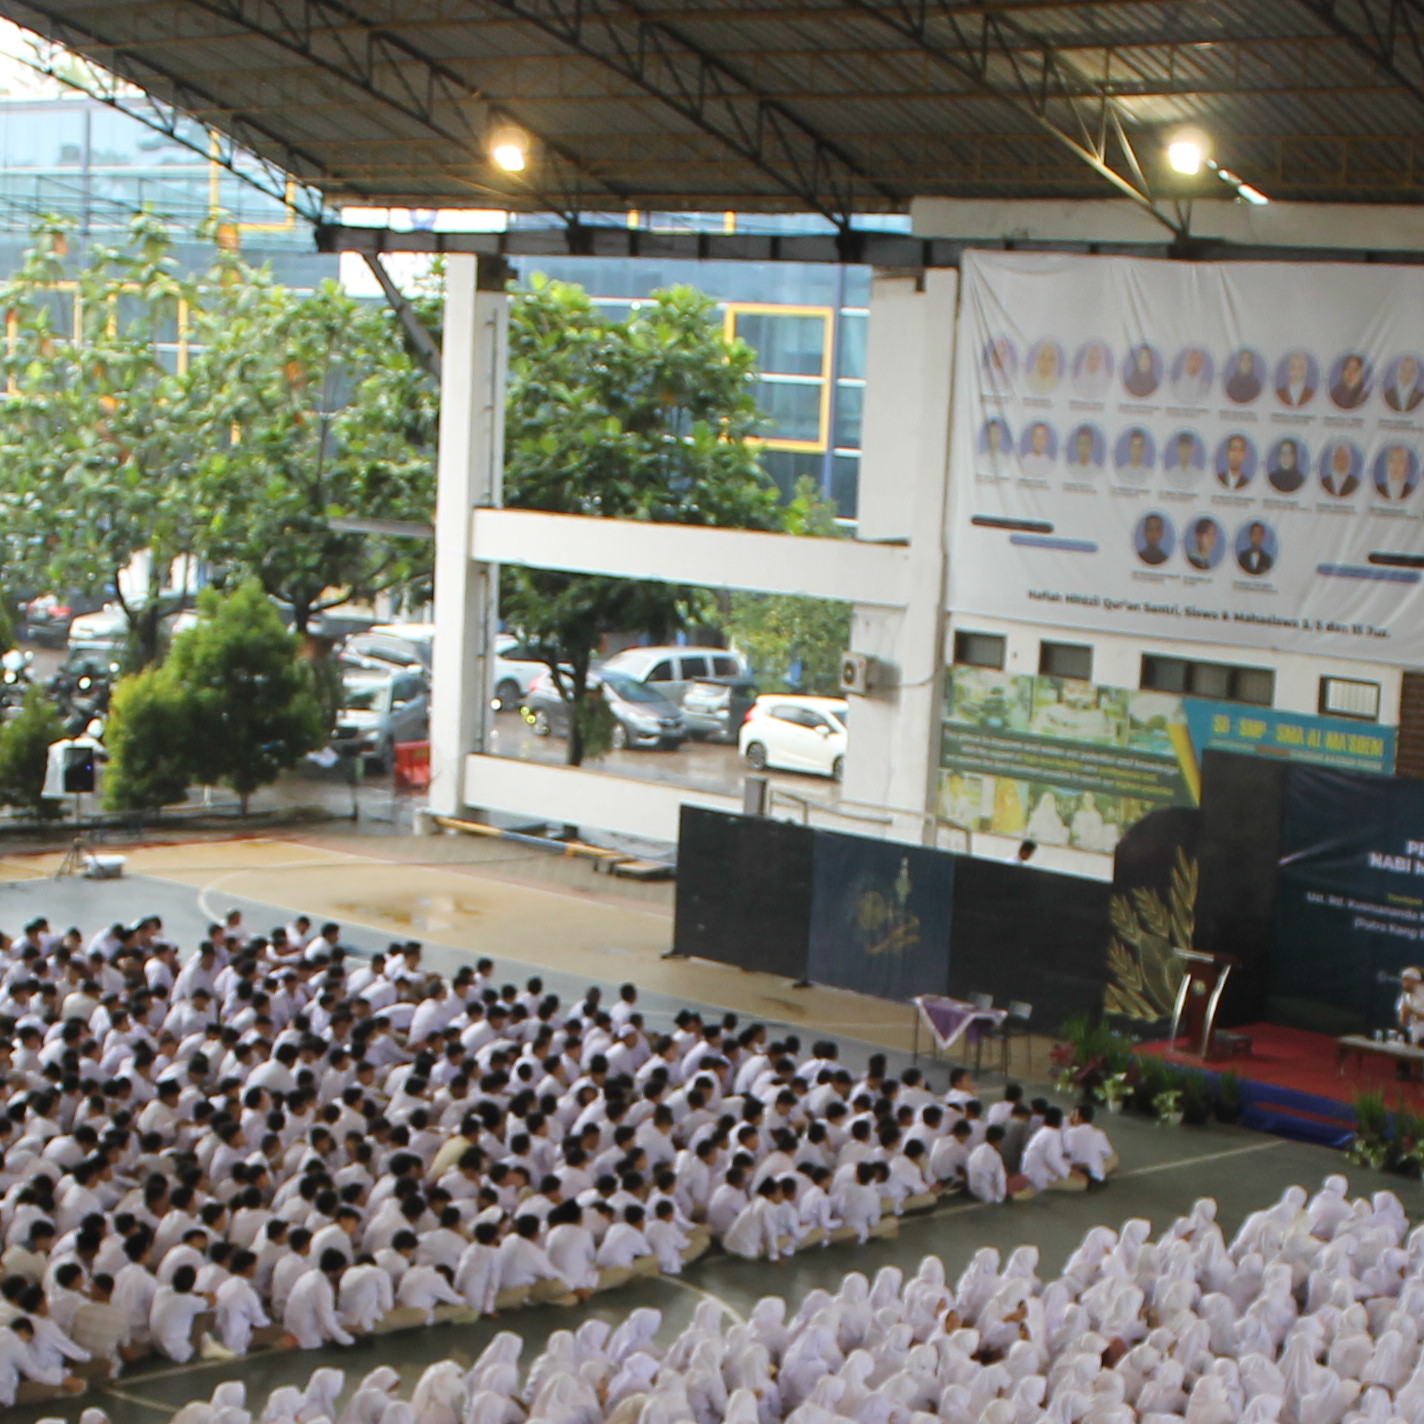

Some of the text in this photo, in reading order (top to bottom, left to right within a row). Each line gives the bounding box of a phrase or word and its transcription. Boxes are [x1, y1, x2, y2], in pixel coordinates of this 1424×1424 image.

[1239, 717, 1267, 739] SMP
[1276, 723, 1304, 745] SMA
[1307, 728, 1321, 748] AL
[1368, 852, 1411, 873] NABI
